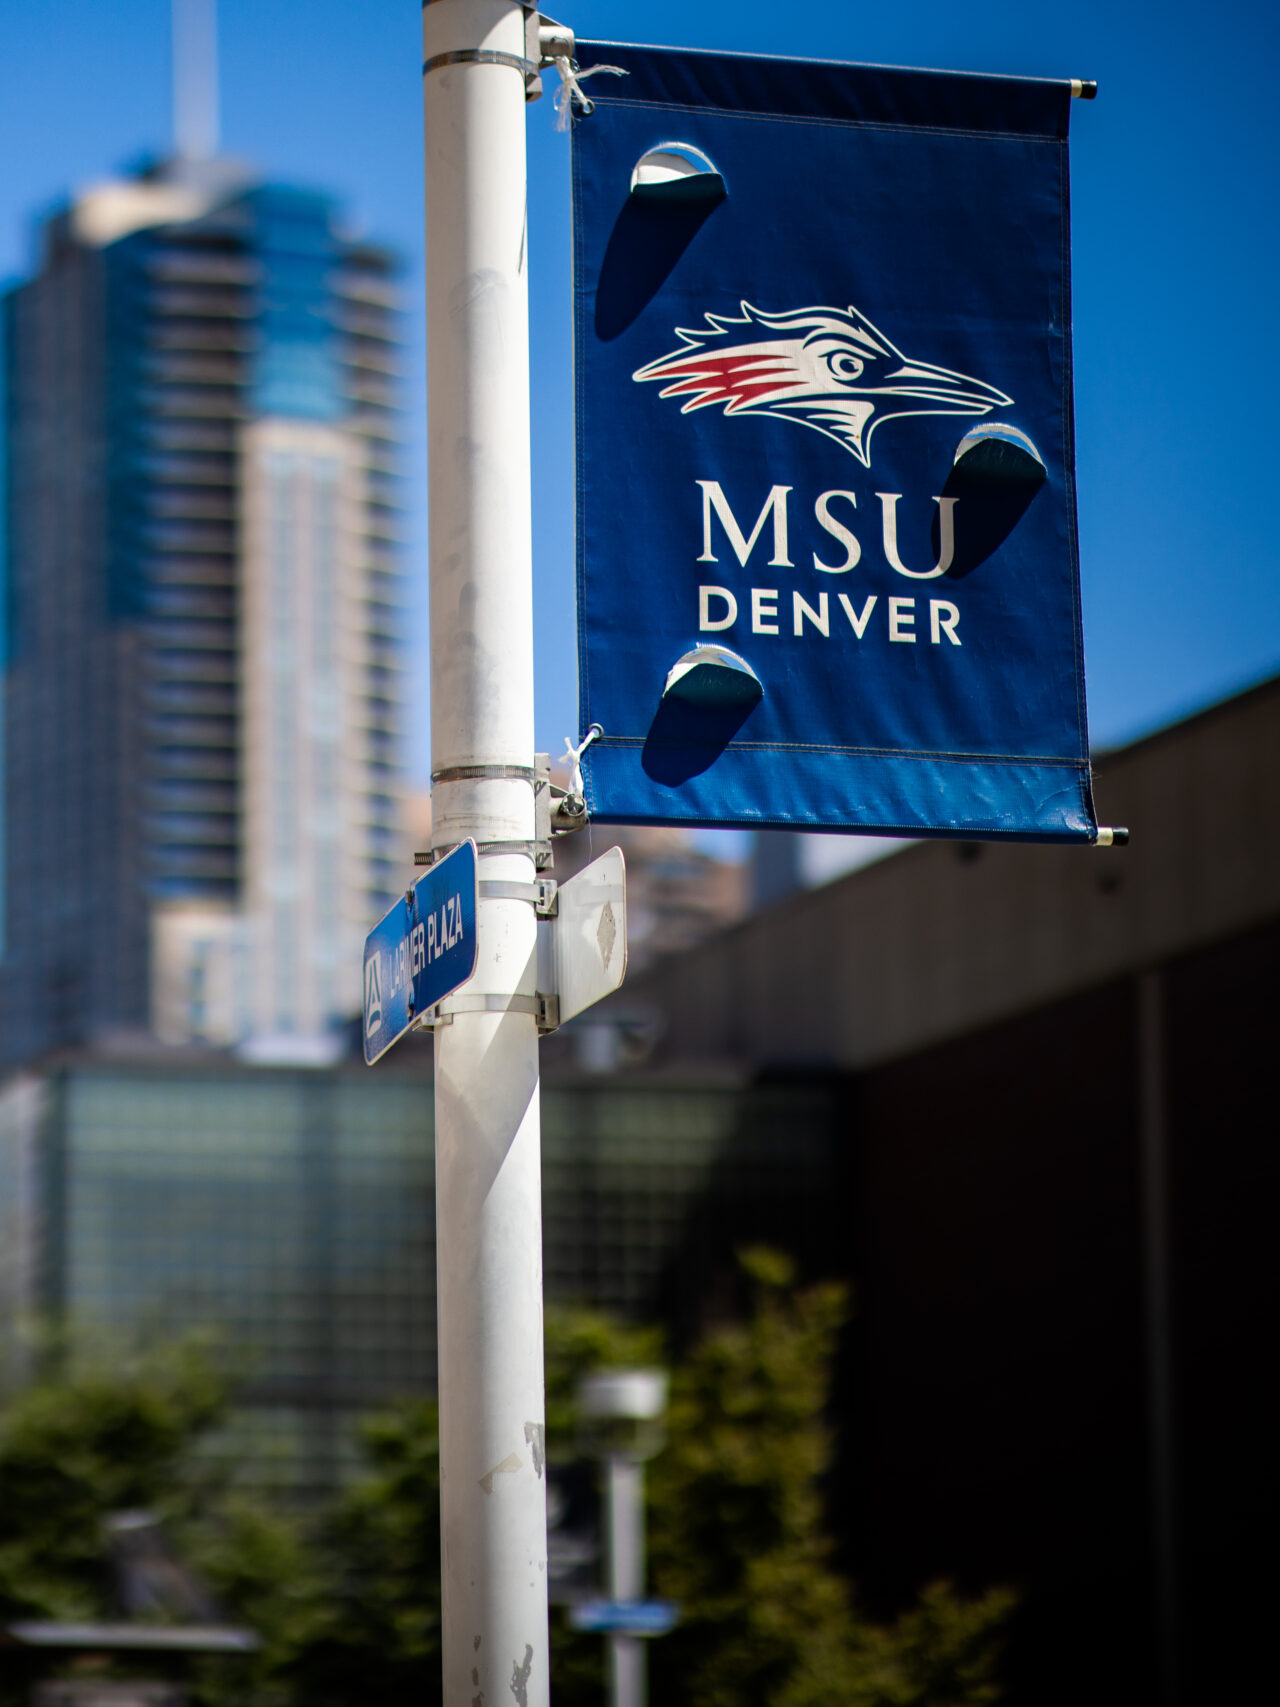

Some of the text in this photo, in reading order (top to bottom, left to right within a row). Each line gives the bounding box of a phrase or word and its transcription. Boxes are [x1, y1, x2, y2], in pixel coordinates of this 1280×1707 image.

[695, 479, 961, 579] MSU
[698, 585, 963, 646] DENVER
[427, 893, 463, 965] PLAZA
